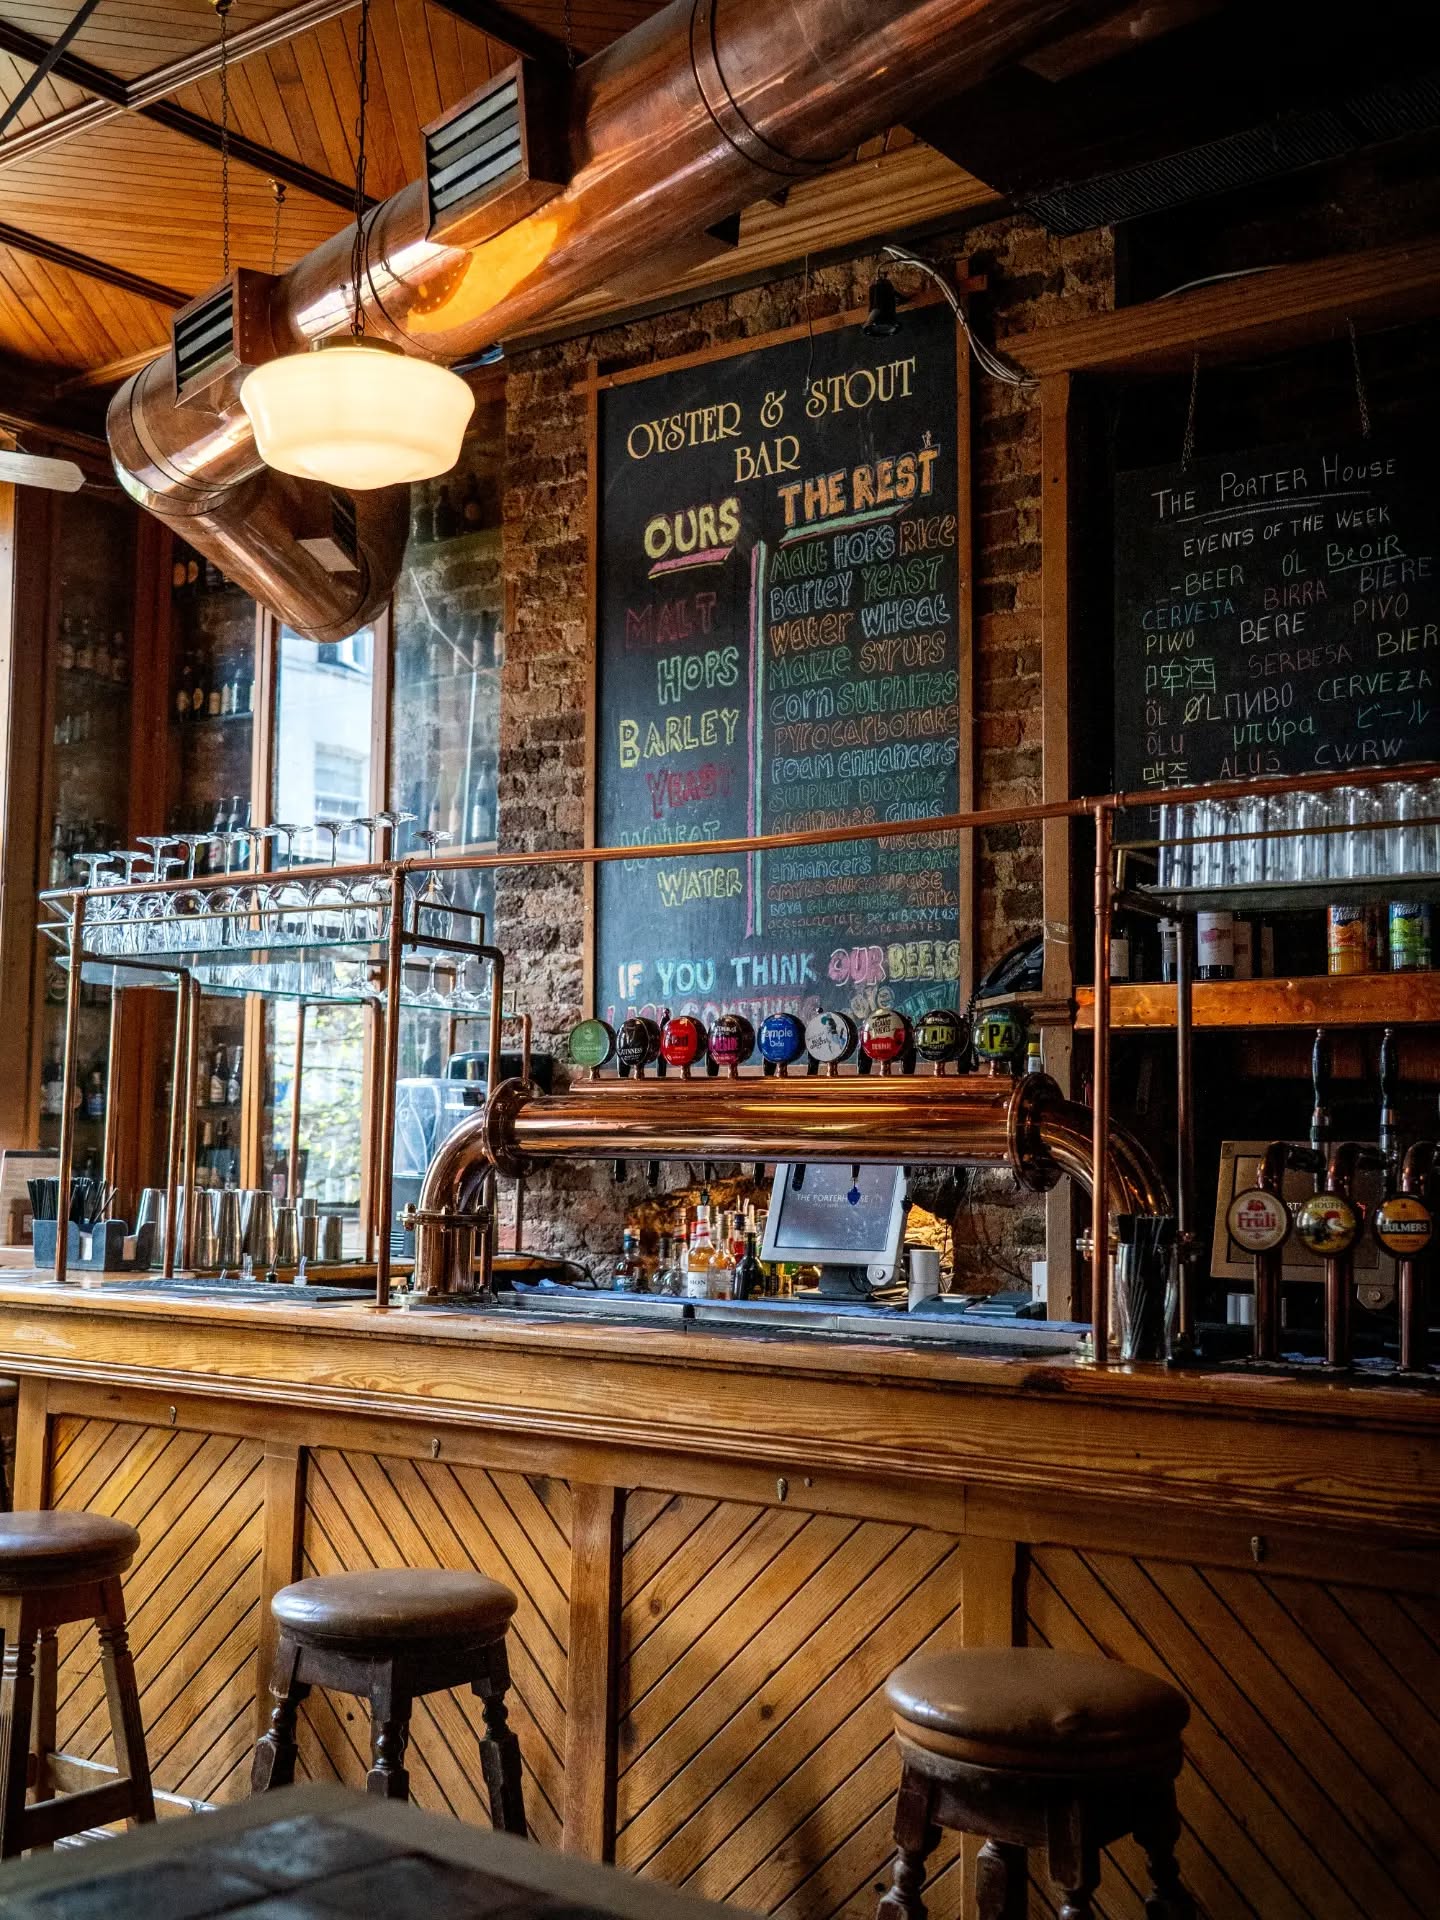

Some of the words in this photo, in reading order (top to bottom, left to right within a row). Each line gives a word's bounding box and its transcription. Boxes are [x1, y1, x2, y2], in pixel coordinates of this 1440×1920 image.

[627, 402, 742, 459] OYSTER
[760, 389, 788, 428] &
[805, 356, 917, 418] STOUT
[734, 434, 801, 483] BAR
[778, 471, 850, 528] THE
[852, 444, 941, 512] REST
[1151, 489, 1196, 518] THE
[1220, 468, 1308, 502] PORTER
[1322, 454, 1396, 486] HOUSE
[644, 497, 743, 558] OURS
[833, 525, 896, 570] HOPS
[1183, 529, 1255, 557] EVENTS
[1263, 522, 1284, 540] OF
[1290, 515, 1325, 536] THE
[1336, 505, 1391, 529] WEEK
[1142, 599, 1235, 630] CERVEJA
[1264, 580, 1329, 610] BIRRA
[1353, 592, 1409, 625] PIVO
[1146, 629, 1196, 655] PIWO
[1240, 612, 1306, 645] BERE
[1377, 624, 1438, 657] BIER
[657, 646, 740, 706] HOPS
[1249, 644, 1353, 679] SERBESA
[1317, 669, 1432, 702] CERVEZA
[619, 707, 740, 769] BARLEY
[1220, 751, 1280, 779] ALUS
[1314, 739, 1403, 765] CWRW
[657, 867, 743, 907] WATER
[617, 959, 645, 1000] IF
[656, 957, 716, 997] YOU
[729, 951, 818, 988] THINK
[763, 1027, 793, 1040] emple
[813, 1194, 869, 1203] PORTERHSE
